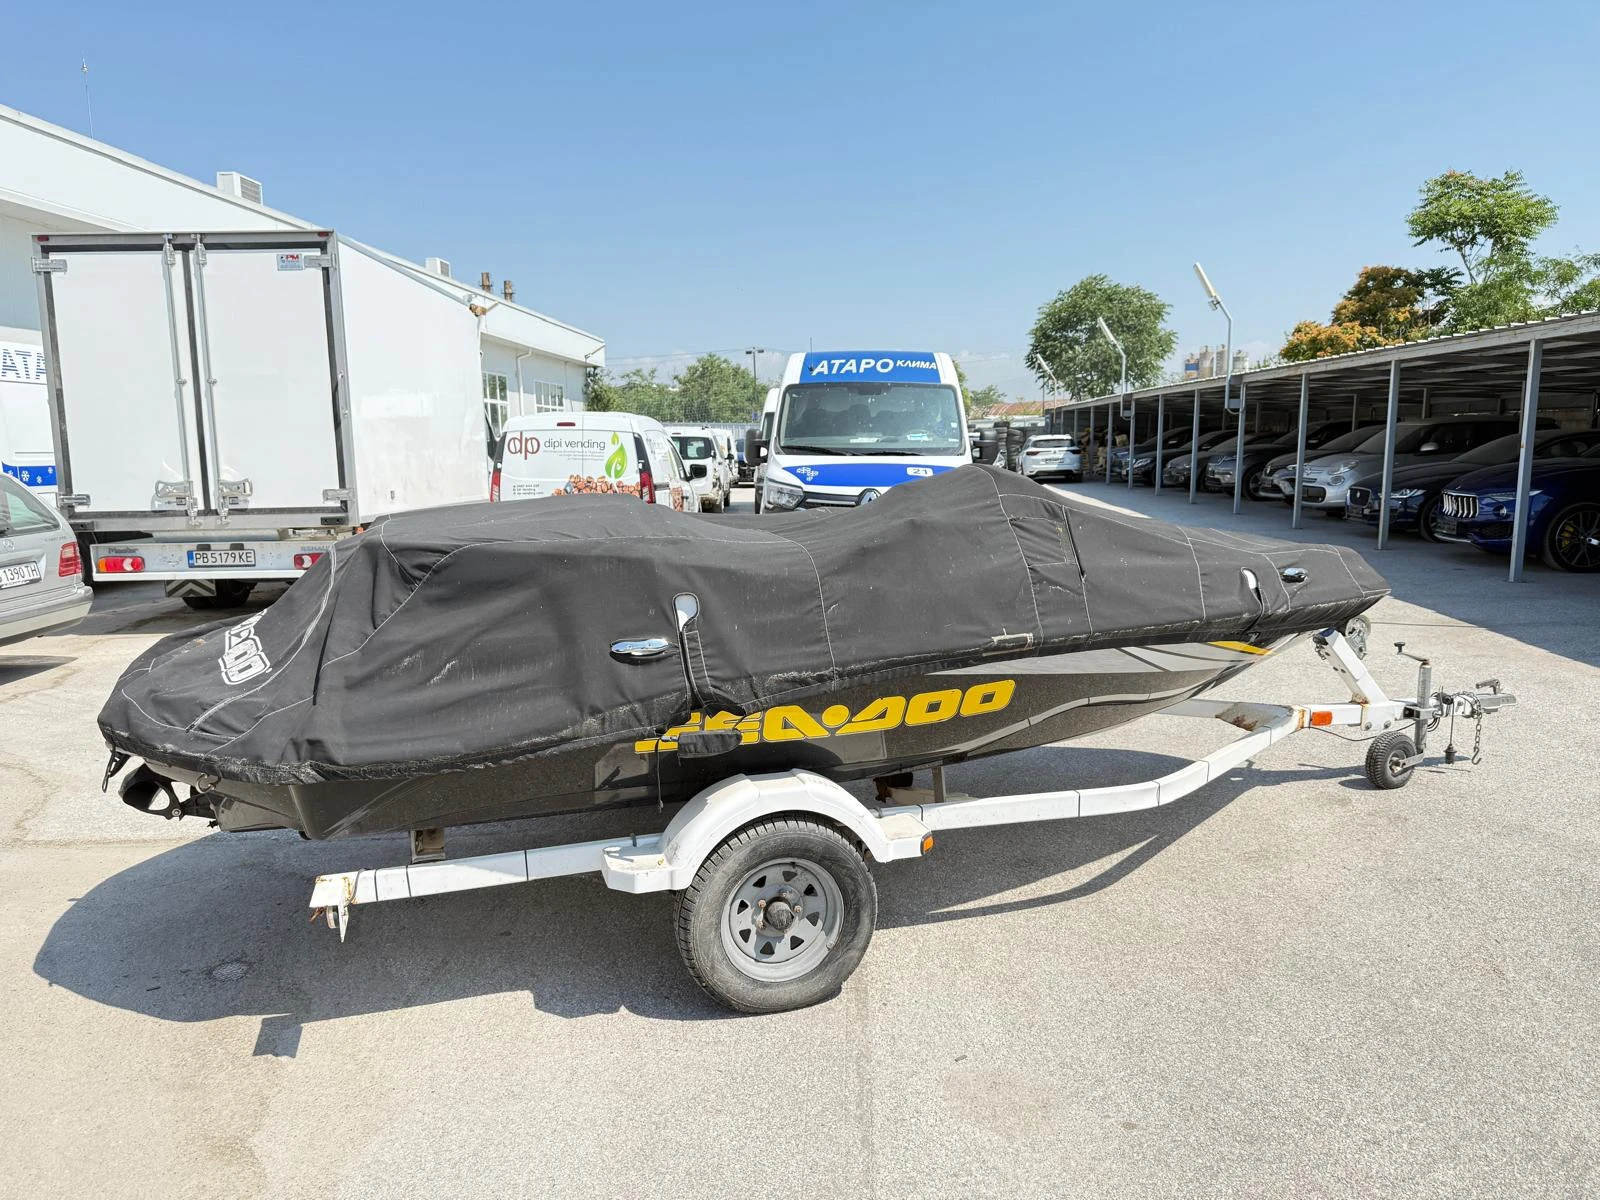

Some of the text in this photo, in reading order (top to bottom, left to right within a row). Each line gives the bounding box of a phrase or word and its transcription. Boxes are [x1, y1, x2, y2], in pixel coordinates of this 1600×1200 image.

[811, 358, 938, 376] АТАРО КЛИМА
[544, 438, 606, 452] dipi vending
[194, 552, 209, 564] PB
[210, 551, 237, 564] 5179
[238, 551, 253, 563] KE
[3, 566, 25, 582] 1390
[25, 564, 39, 578] TH
